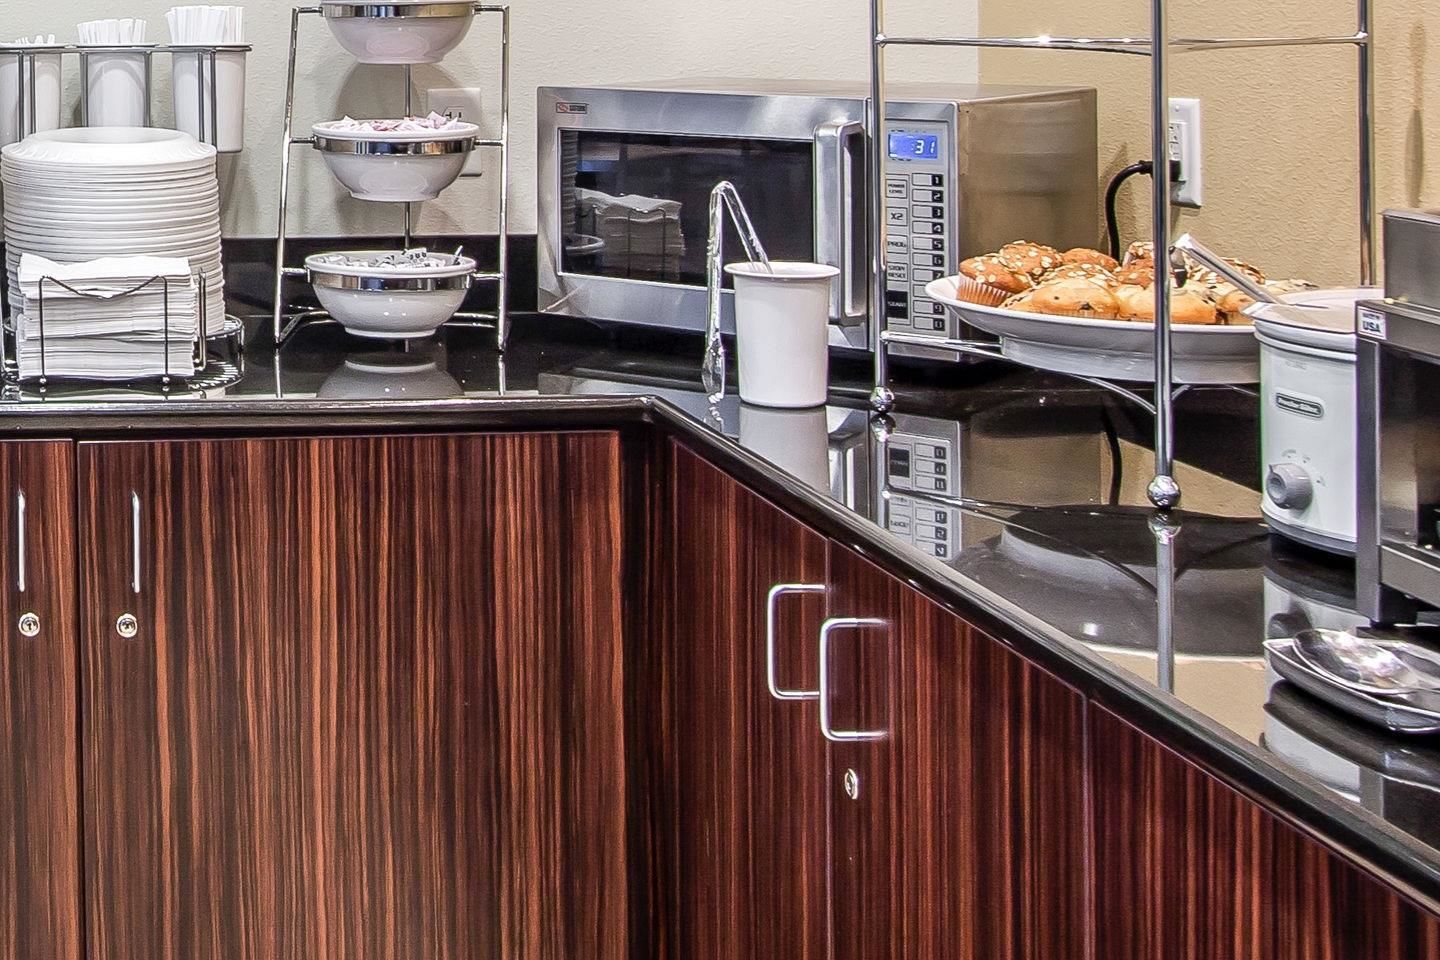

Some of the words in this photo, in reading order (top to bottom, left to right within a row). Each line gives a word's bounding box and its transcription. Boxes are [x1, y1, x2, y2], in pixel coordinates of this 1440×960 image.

[890, 212, 904, 221] X2
[934, 208, 941, 217] 3
[933, 224, 941, 232] 4
[933, 240, 942, 248] 5
[933, 256, 942, 264] 6
[1362, 320, 1381, 333] USA
